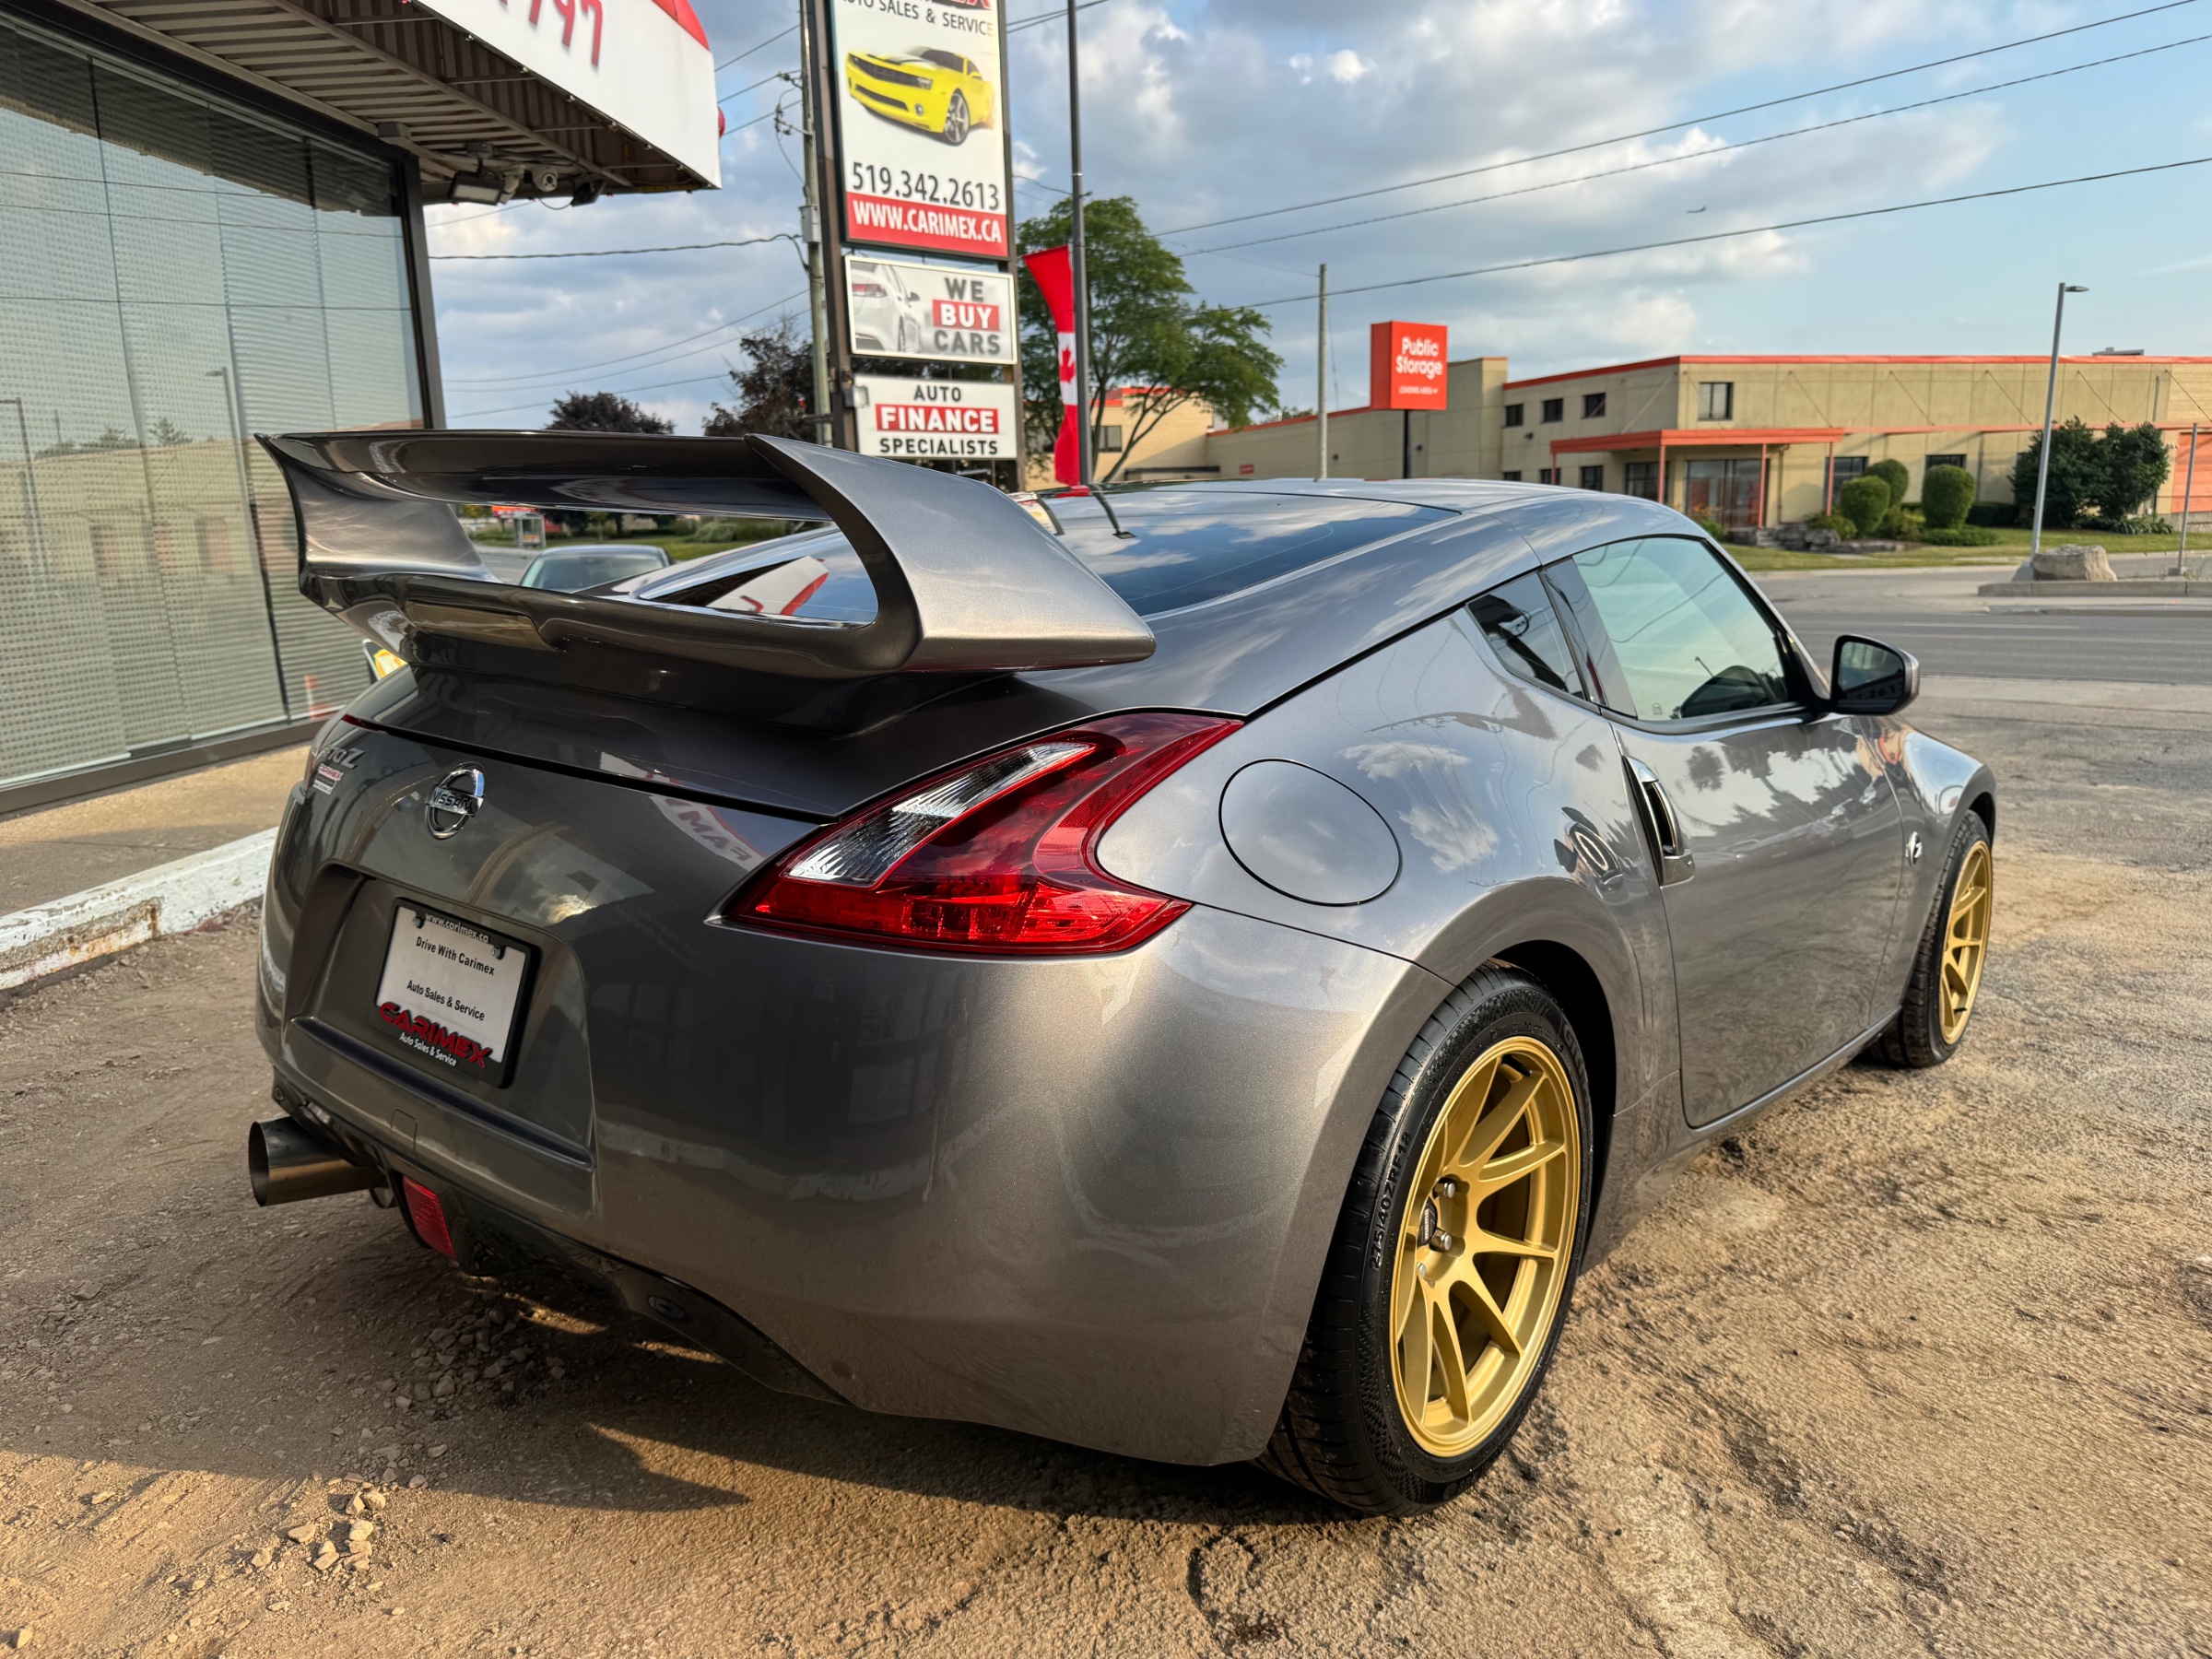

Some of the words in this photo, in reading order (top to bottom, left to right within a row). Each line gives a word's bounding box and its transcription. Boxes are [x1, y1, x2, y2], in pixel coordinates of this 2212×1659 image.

[879, 0, 919, 20] SALES
[925, 8, 935, 24] &
[943, 12, 994, 37] SERVICE
[853, 161, 1000, 211] 519.342.2613
[853, 199, 1003, 243] WWW.CARIMEX.CA
[944, 277, 984, 302] WE
[940, 302, 993, 329] BUY
[934, 330, 1001, 355] CARS
[1402, 336, 1439, 357] Public
[1395, 355, 1443, 380] Storage
[913, 385, 961, 402] AUTO
[880, 406, 995, 433] FINANCE
[879, 438, 998, 454] SPECIALISTS
[431, 790, 473, 810] NISSAN
[425, 912, 490, 944] www.carimex.ca
[416, 935, 436, 953] Drive
[438, 944, 457, 961] With
[458, 952, 495, 976] Carimex
[406, 979, 424, 995] Auto
[424, 986, 445, 1005] Sales
[446, 995, 453, 1008] &
[454, 1000, 485, 1021] Service
[379, 1001, 491, 1069] CARIMEX
[399, 1031, 414, 1046] Auto
[413, 1038, 429, 1054] Sales
[429, 1046, 435, 1056] &
[435, 1048, 457, 1067] Service
[1368, 1133, 1412, 1271] 275/40ZRF18
